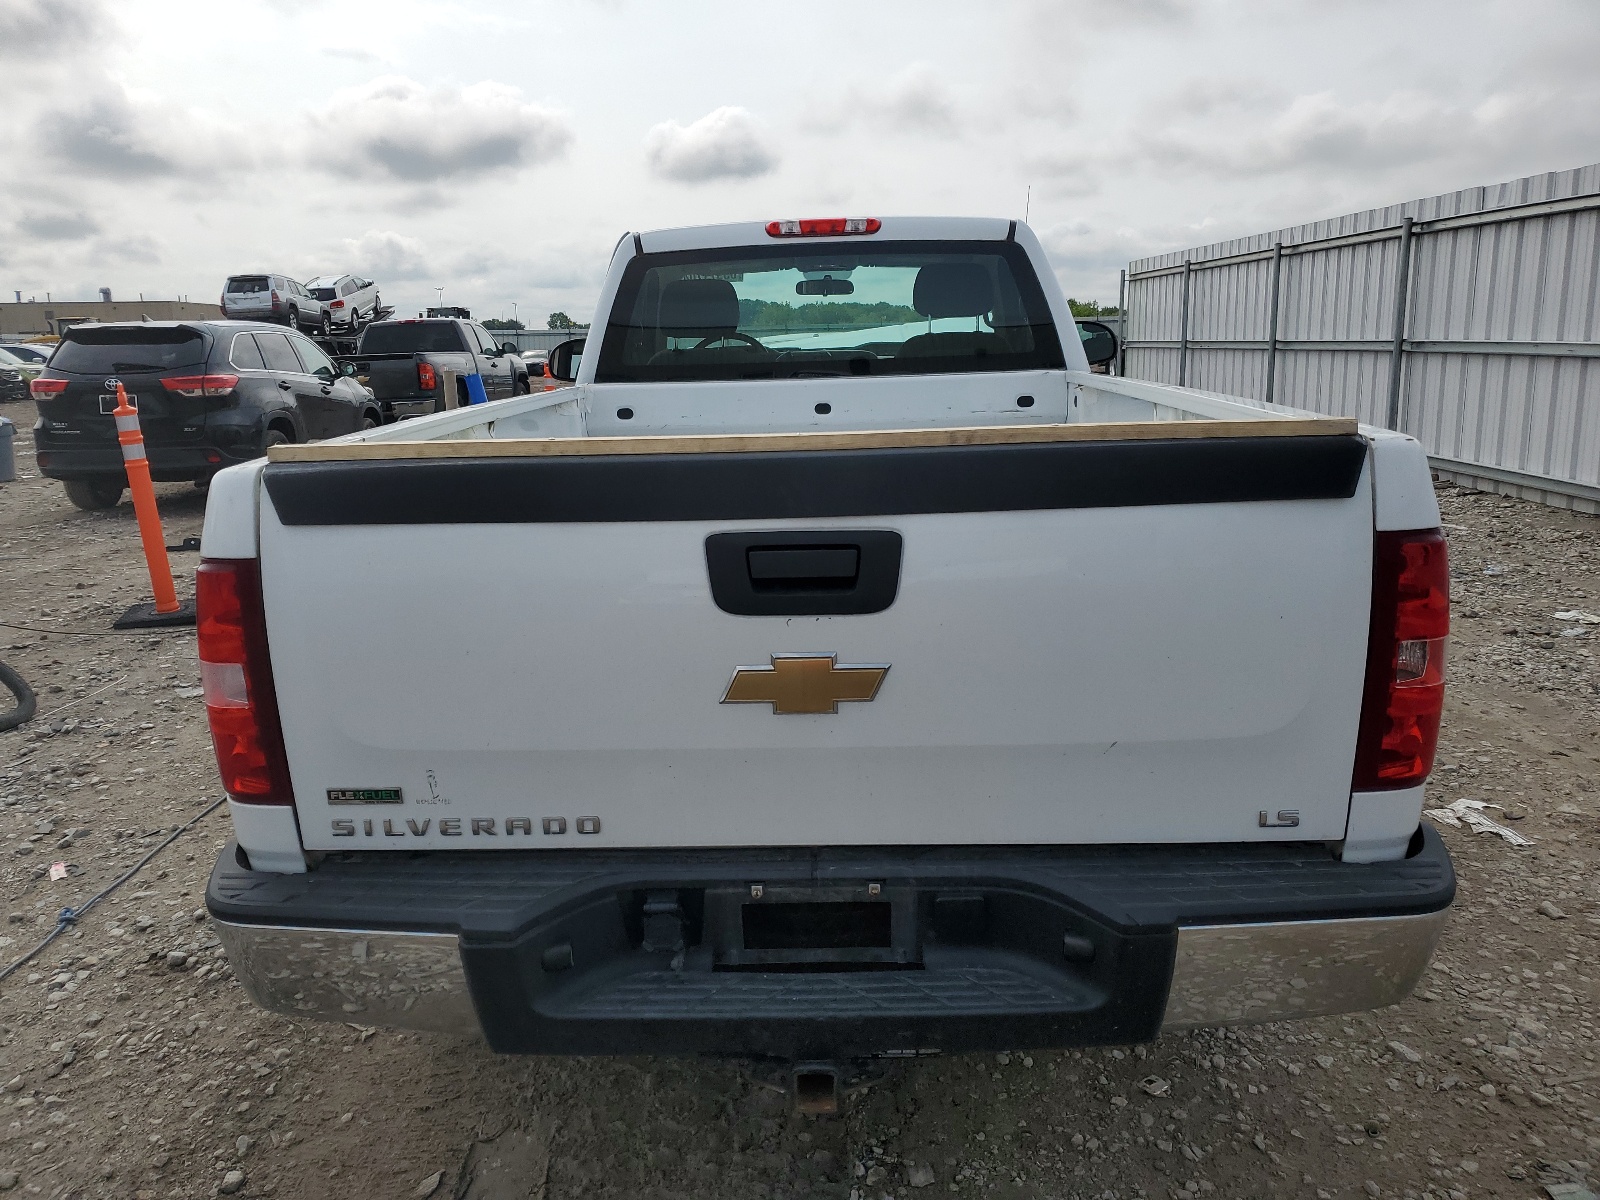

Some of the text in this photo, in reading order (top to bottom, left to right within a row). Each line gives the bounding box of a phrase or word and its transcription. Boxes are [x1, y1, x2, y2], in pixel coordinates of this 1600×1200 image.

[330, 790, 400, 800] FLEXFUEL
[331, 816, 602, 837] SILVERADO
[1259, 809, 1299, 827] LS
